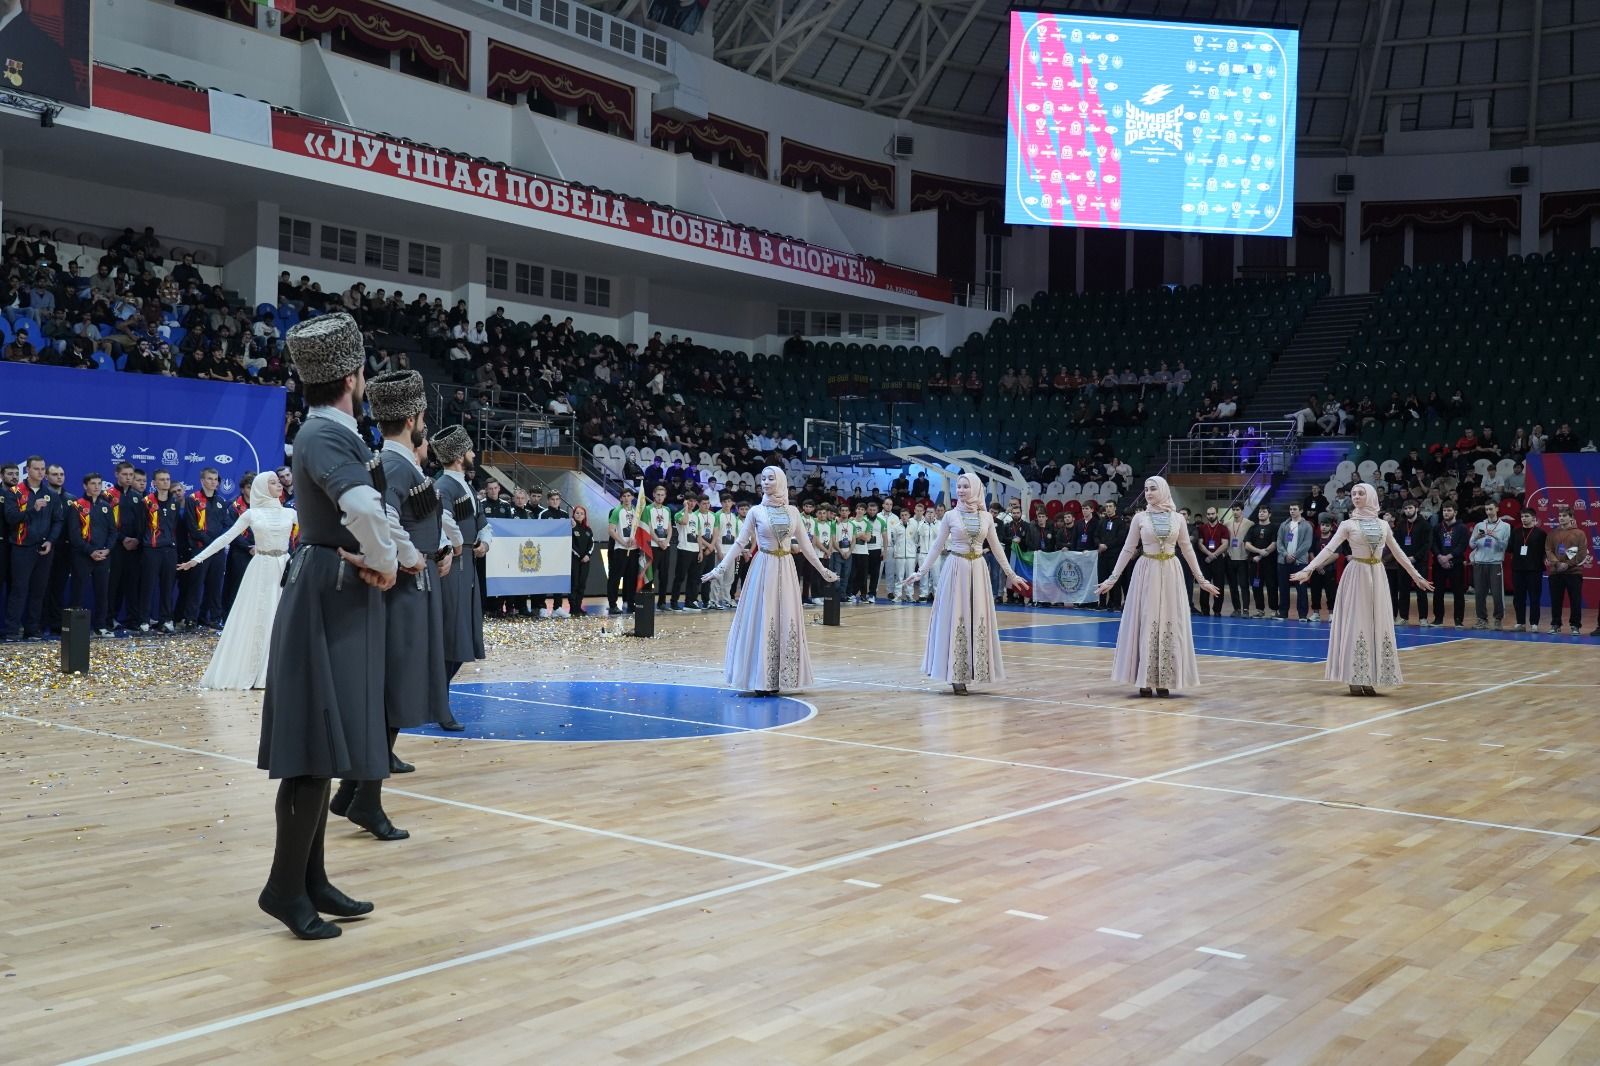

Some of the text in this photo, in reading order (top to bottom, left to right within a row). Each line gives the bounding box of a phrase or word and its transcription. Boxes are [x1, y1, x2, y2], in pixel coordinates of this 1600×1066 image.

[303, 129, 499, 197] «ЛУЧШАЯ
[506, 172, 630, 227] ПОБЕДА
[651, 209, 754, 258] ПОБЕДА
[759, 238, 774, 262] В
[778, 240, 876, 285] СПОРТЕ!»
